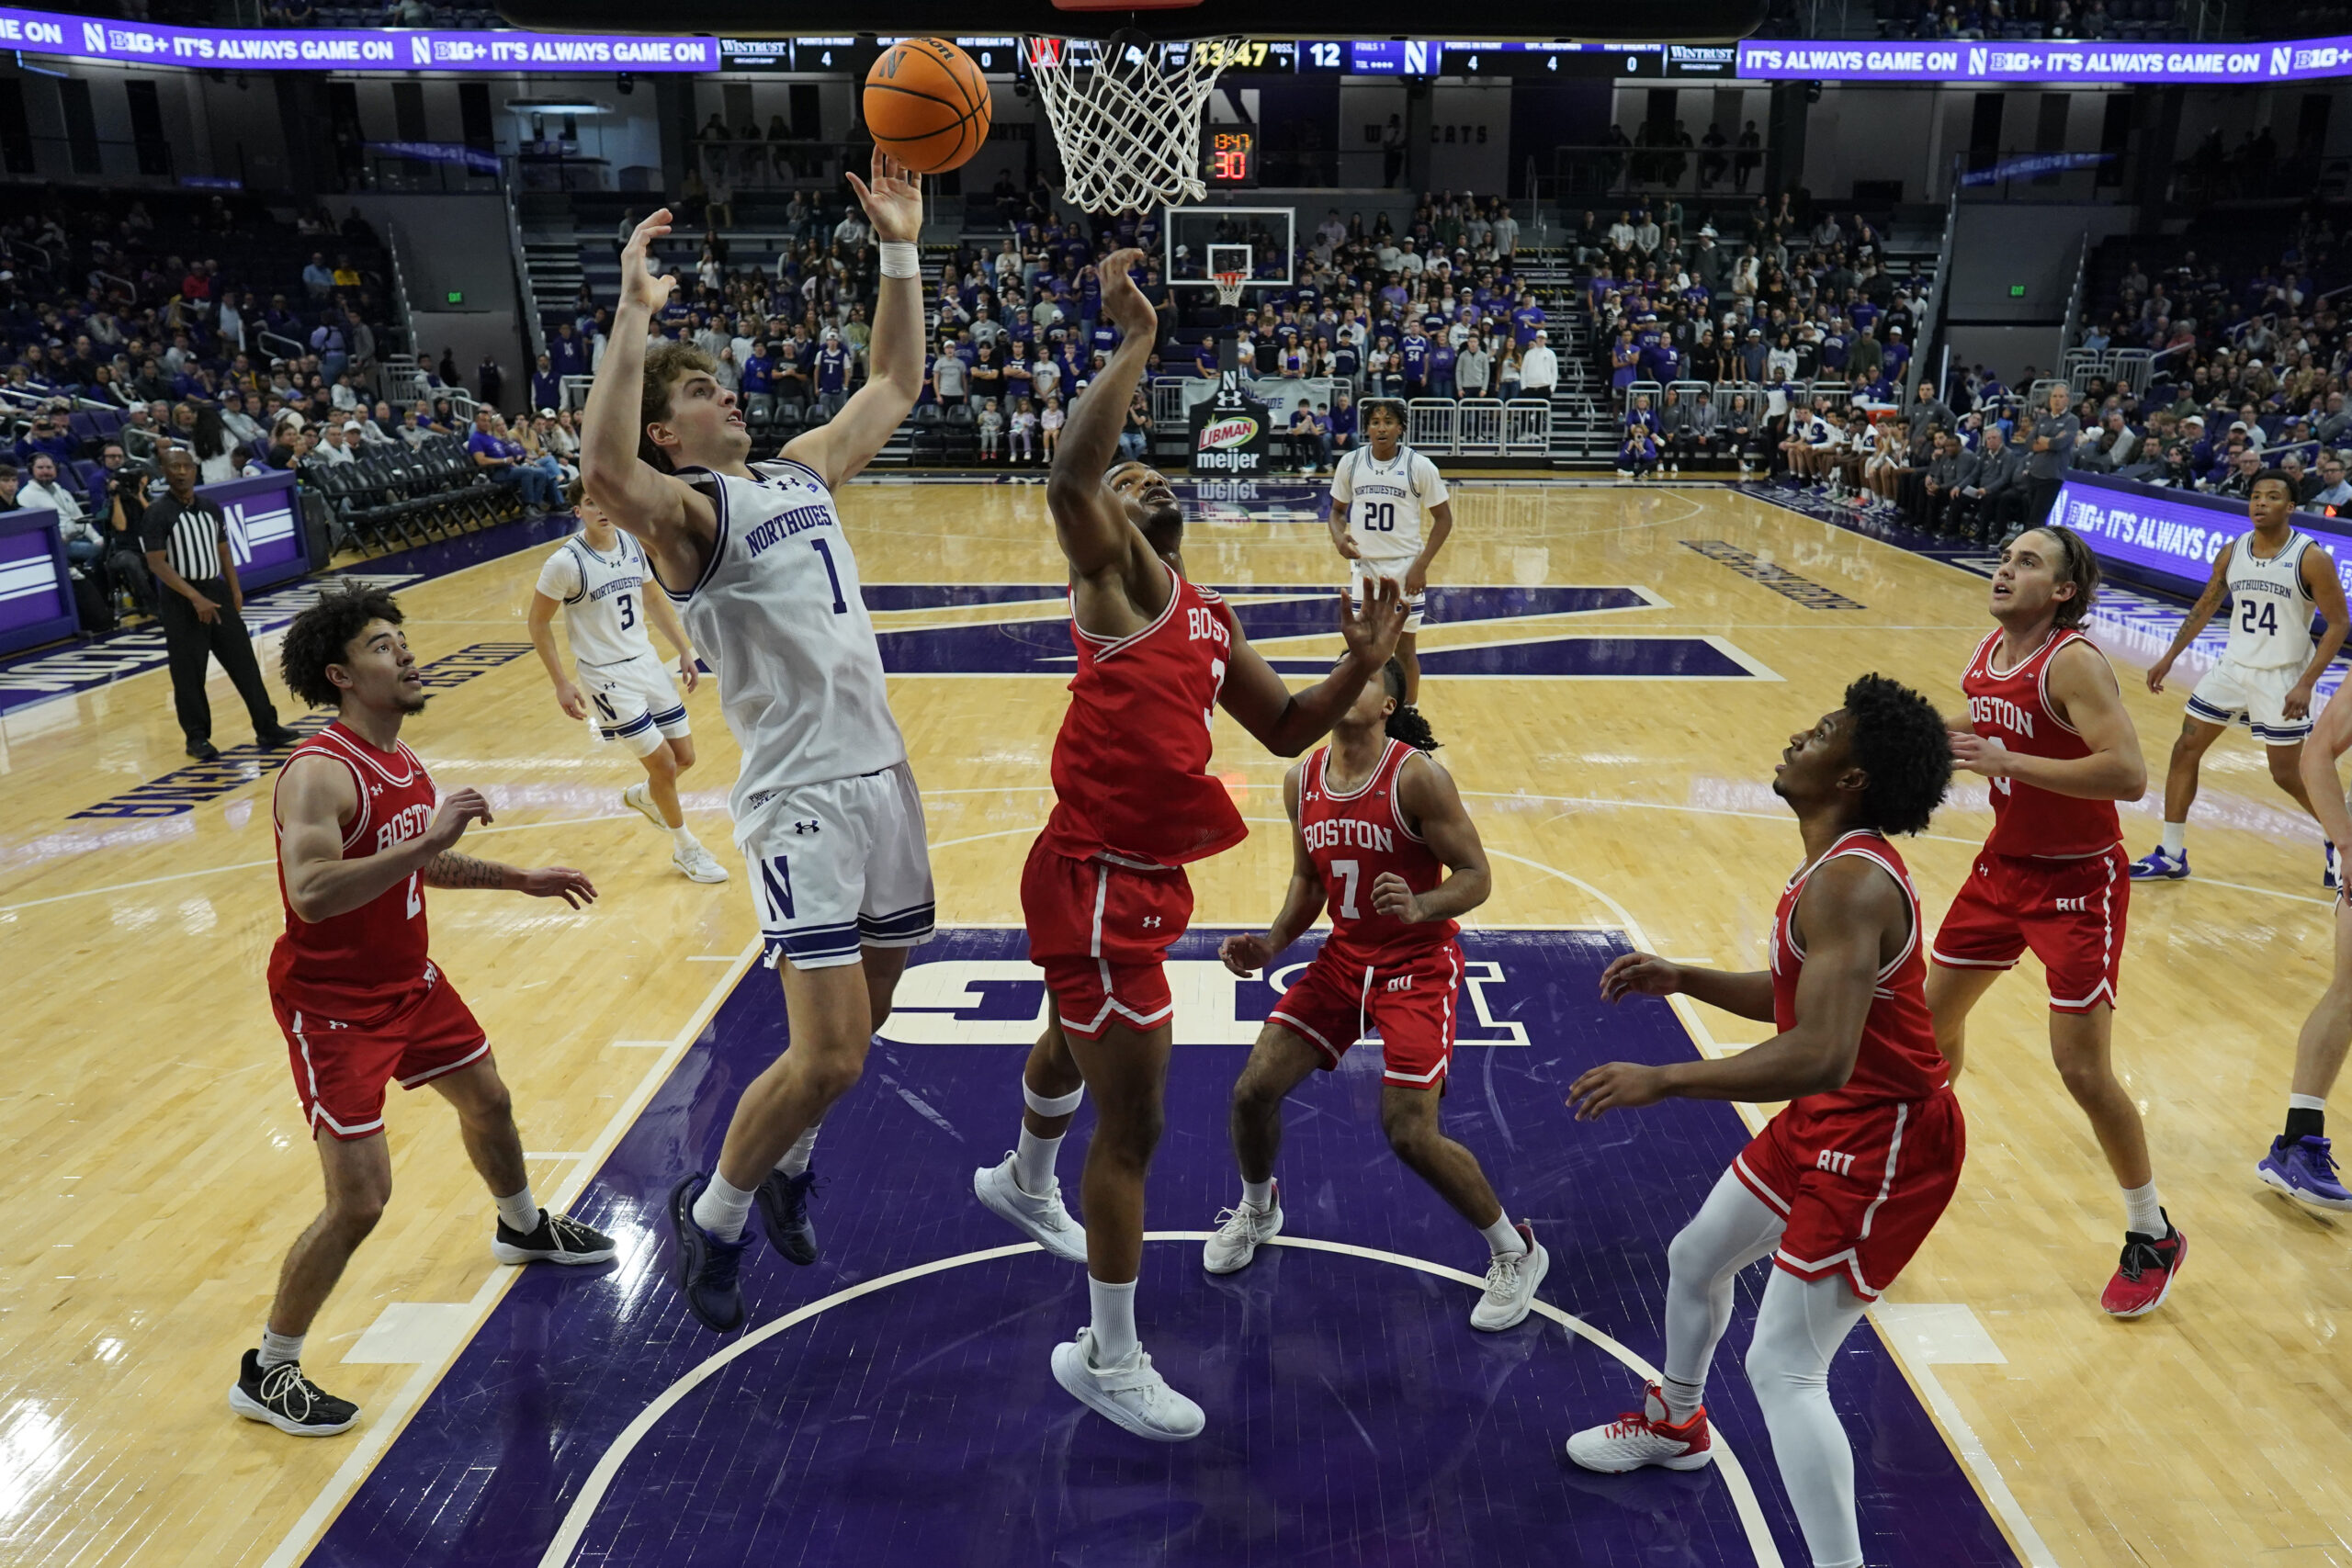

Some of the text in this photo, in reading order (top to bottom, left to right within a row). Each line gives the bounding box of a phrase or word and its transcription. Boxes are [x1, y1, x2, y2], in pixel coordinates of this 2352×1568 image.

[25, 22, 63, 44] ON
[83, 22, 107, 52] N
[173, 37, 212, 58] IT'S
[217, 39, 299, 60] ALWAYS
[301, 40, 359, 60] GAME
[362, 41, 394, 60] ON
[721, 39, 786, 52] WINTRUST
[412, 37, 432, 64] N
[491, 42, 529, 61] IT'S
[532, 42, 610, 62] ALWAYS
[614, 43, 672, 62] GAME
[674, 43, 706, 62] ON
[821, 51, 832, 67] 4
[981, 52, 992, 68] 0
[1196, 42, 1268, 67] 13:47
[1309, 42, 1340, 67] 12
[1404, 41, 1427, 74] N
[1468, 55, 1478, 71] 4
[1547, 56, 1558, 72] 4
[1670, 46, 1735, 59] WINTRUST
[1747, 51, 1958, 71] IT'S ALWAYS GAME ON
[1968, 48, 1987, 75] N
[2047, 52, 2084, 72] IT'S
[2086, 53, 2165, 73] ALWAYS
[2166, 53, 2224, 73] GAME
[2227, 53, 2260, 73] ON
[2269, 47, 2291, 75] N
[879, 51, 908, 79] N
[1626, 57, 1637, 72] 0
[1215, 134, 1250, 150] 13:47
[1215, 151, 1246, 179] 30
[1223, 370, 1237, 390] N
[1198, 422, 1253, 450] LIBMAN
[1197, 447, 1260, 473] meijer
[1354, 484, 1408, 499] NORTHWESTERN
[1364, 502, 1395, 532] 20
[223, 503, 253, 567] N
[745, 504, 832, 558] NORTHWES
[2105, 509, 2137, 544] IT'S
[2134, 517, 2206, 560] ALWAYS
[810, 538, 848, 615] 1
[2229, 579, 2291, 599] NORTHWESTERN
[617, 593, 634, 631] 3
[2241, 599, 2278, 636] 24
[592, 693, 617, 722] N
[1304, 818, 1394, 853] BOSTON
[761, 855, 796, 922] N
[1330, 859, 1361, 919] 7
[1387, 974, 1413, 993] BU
